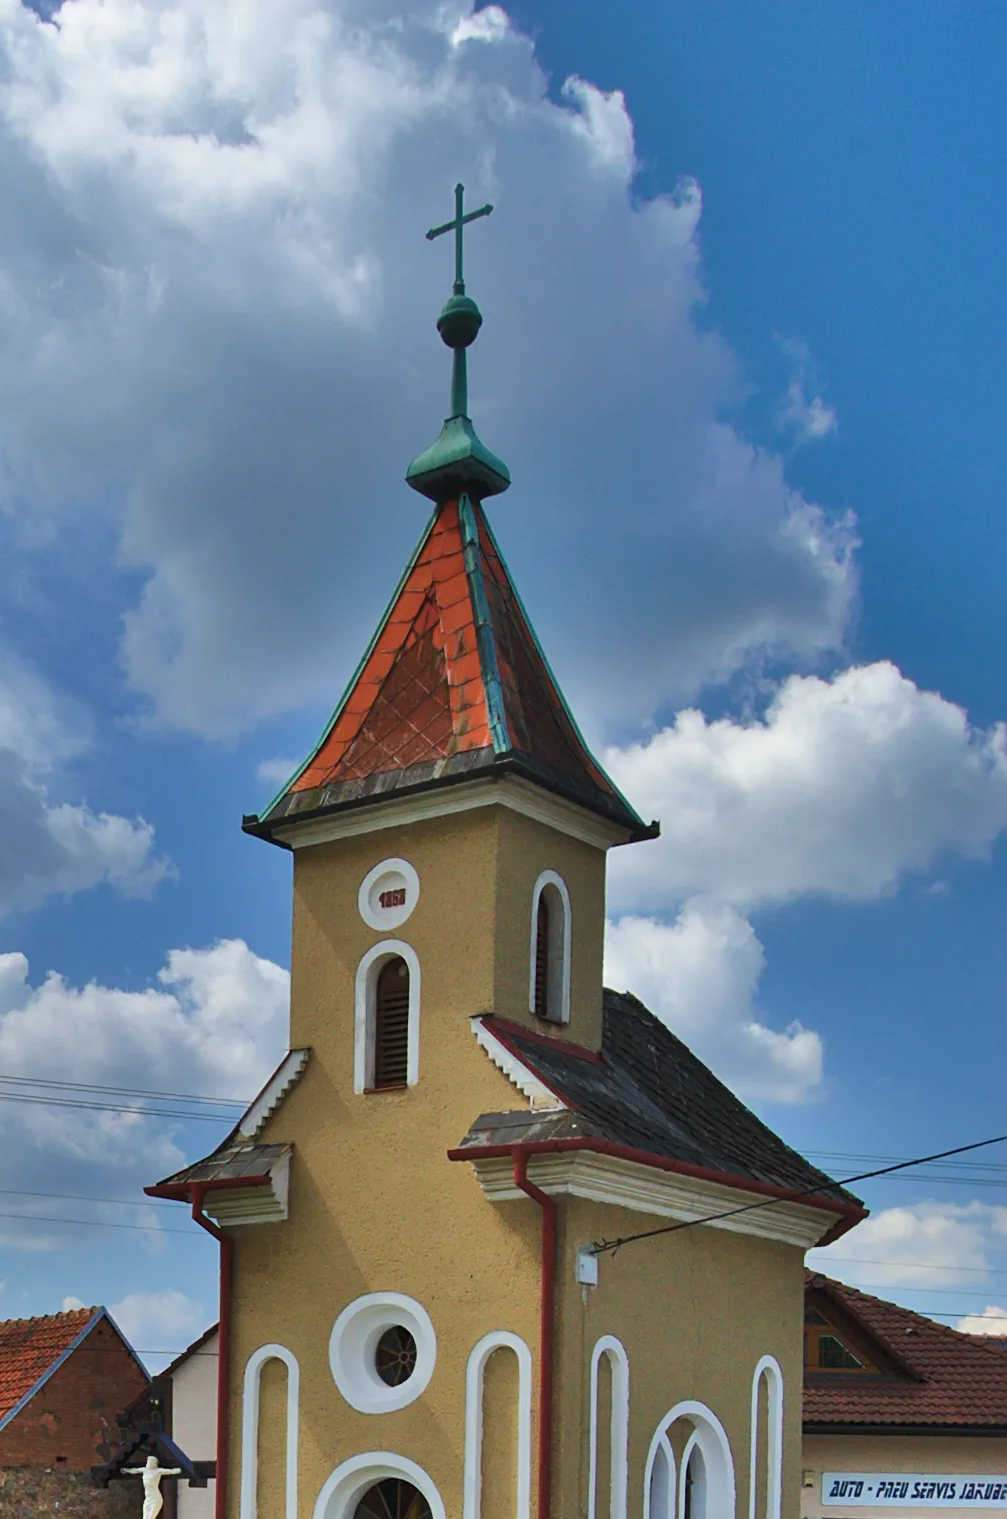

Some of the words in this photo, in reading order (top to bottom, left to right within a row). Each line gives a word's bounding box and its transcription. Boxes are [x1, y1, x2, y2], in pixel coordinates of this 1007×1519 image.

[829, 1480, 865, 1497] AUTO
[875, 1481, 910, 1498] PNEU
[910, 1481, 957, 1499] SERVIS
